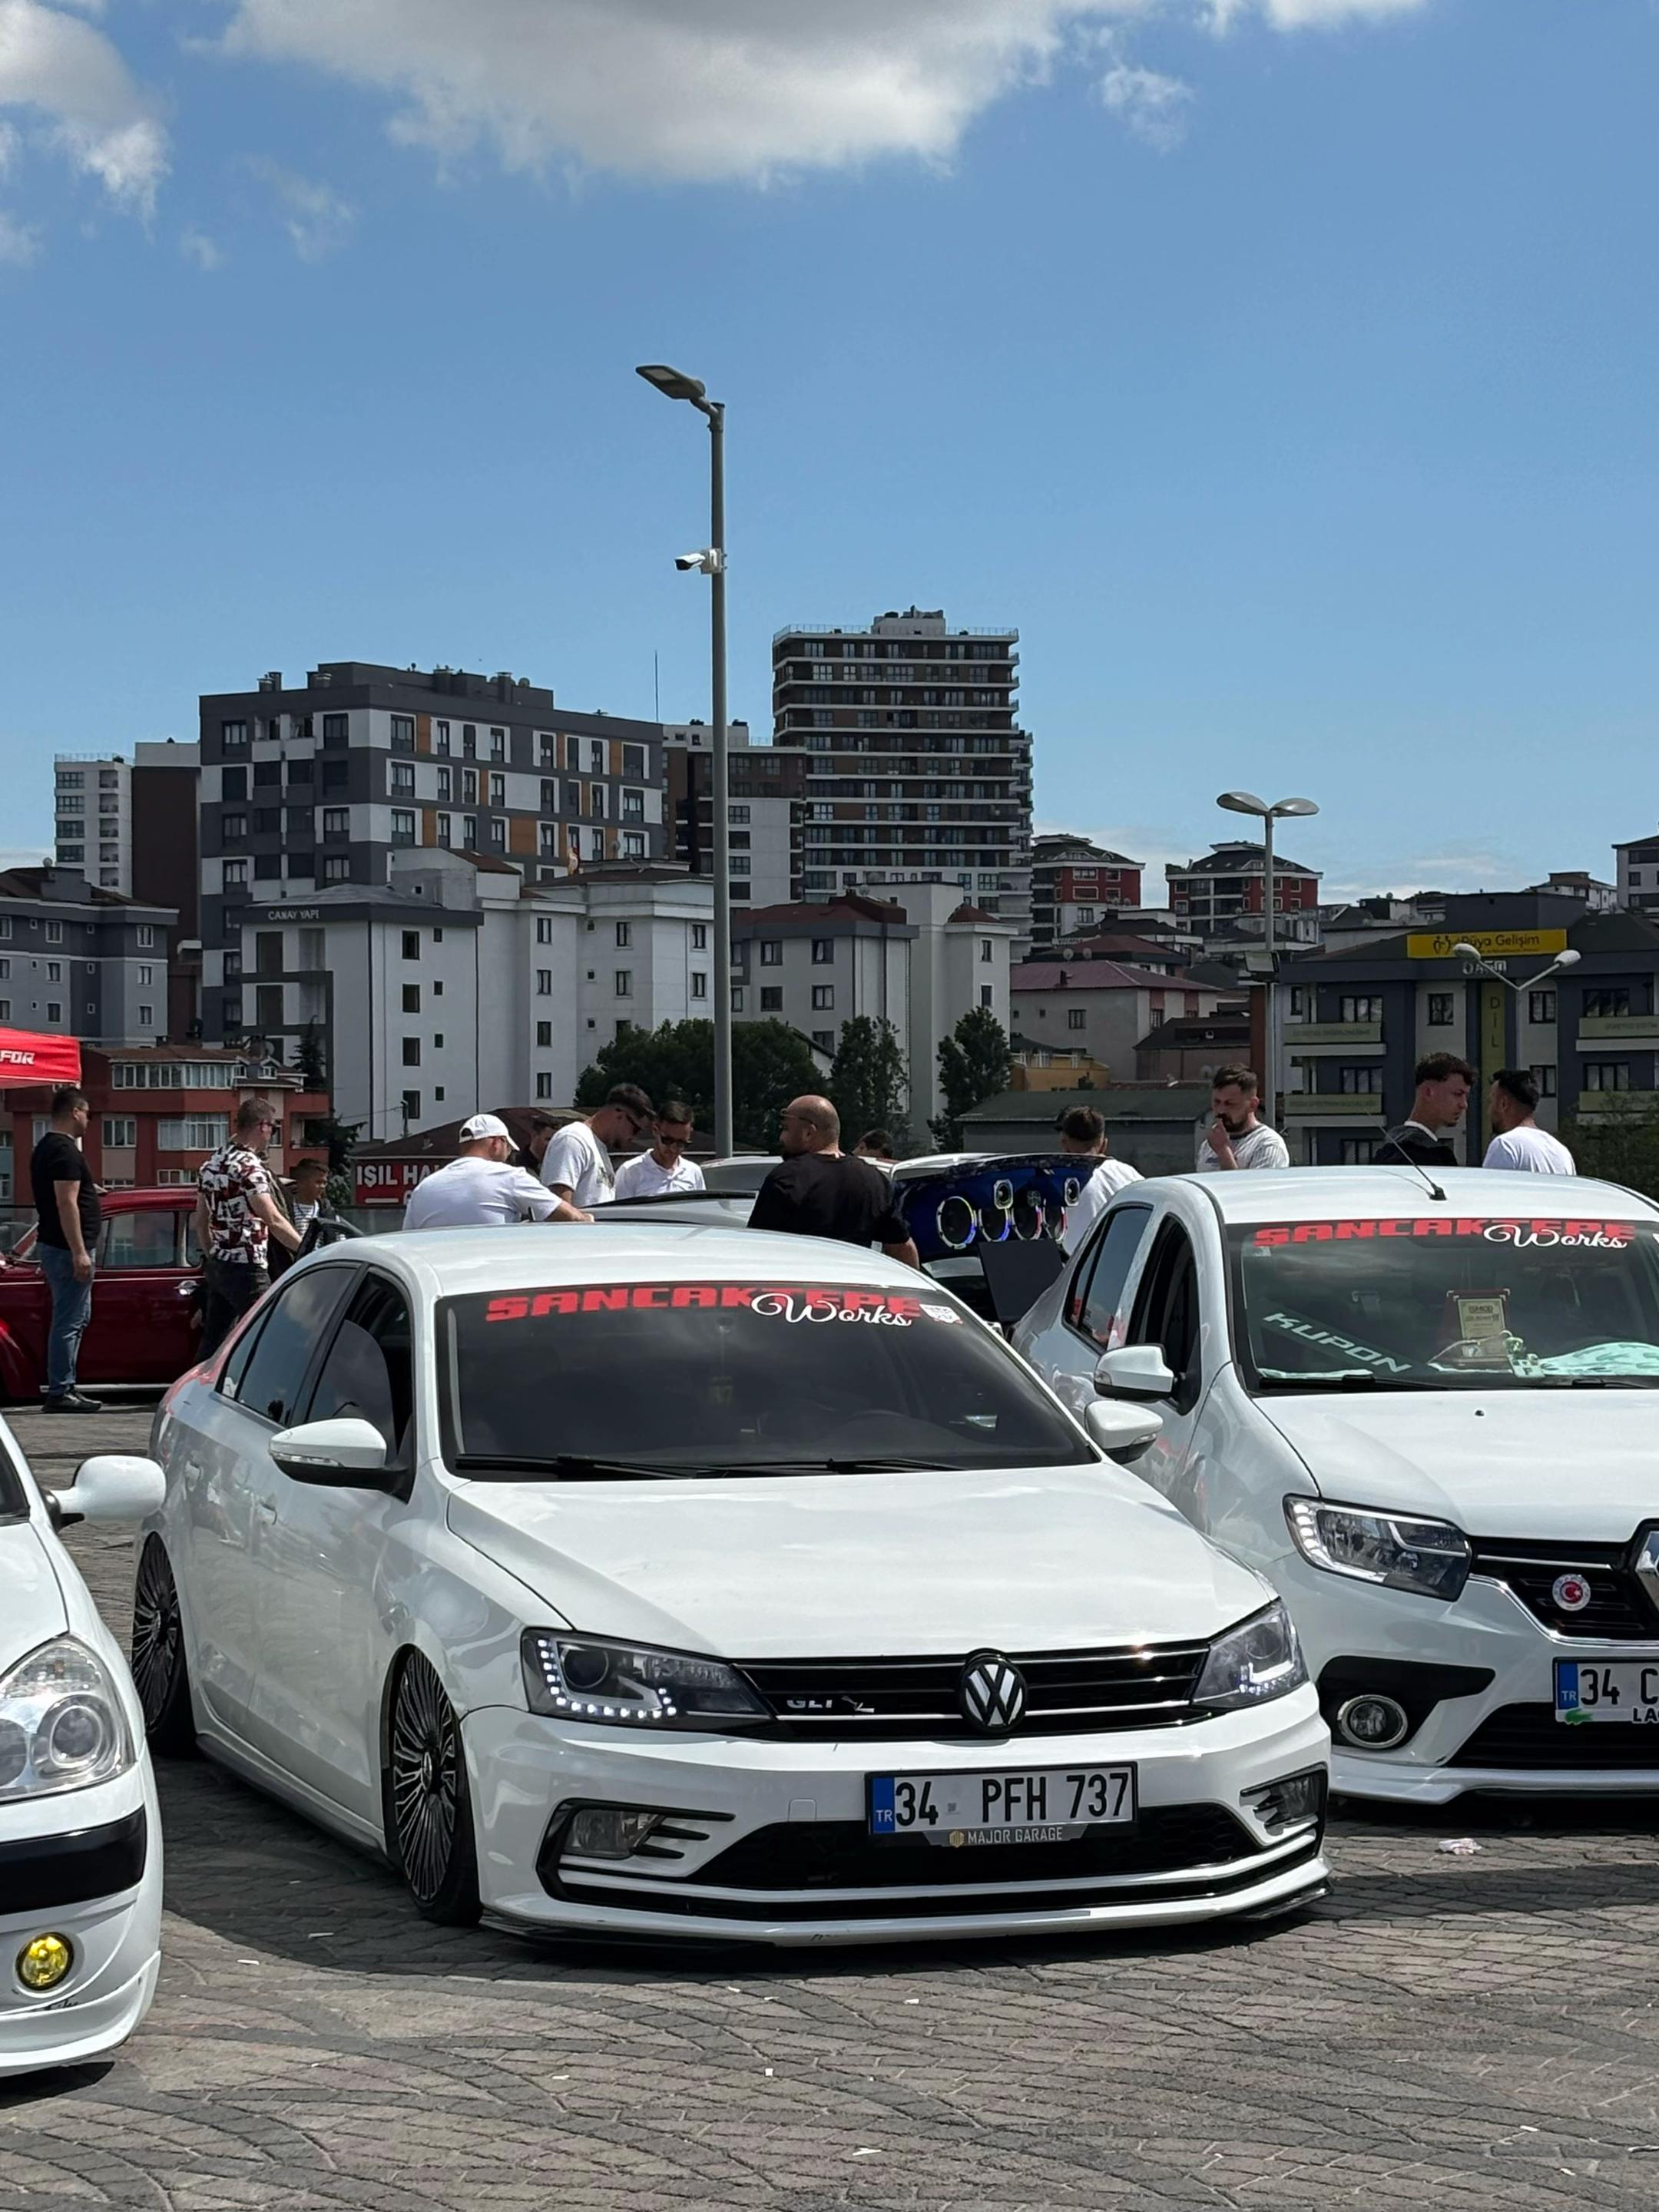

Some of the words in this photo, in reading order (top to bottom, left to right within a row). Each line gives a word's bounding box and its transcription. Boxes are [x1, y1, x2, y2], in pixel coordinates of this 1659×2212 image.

[1495, 933, 1540, 948] Gelişim
[0, 1050, 35, 1065] FOR
[356, 1164, 398, 1188] IŞIL
[403, 1164, 440, 1185] HA
[1483, 1224, 1628, 1249] Works
[750, 1293, 912, 1326] Works
[1263, 1313, 1412, 1373] KUPON
[1561, 1690, 1577, 1702] TR
[1581, 1668, 1621, 1705] 34
[1633, 1707, 1659, 1722] LA
[896, 1781, 939, 1826] 34
[982, 1777, 1047, 1823] PFH
[1066, 1772, 1129, 1820] 737
[876, 1810, 893, 1823] TR
[968, 1829, 1011, 1845] MAJOR
[1015, 1826, 1063, 1843] GARAGE
